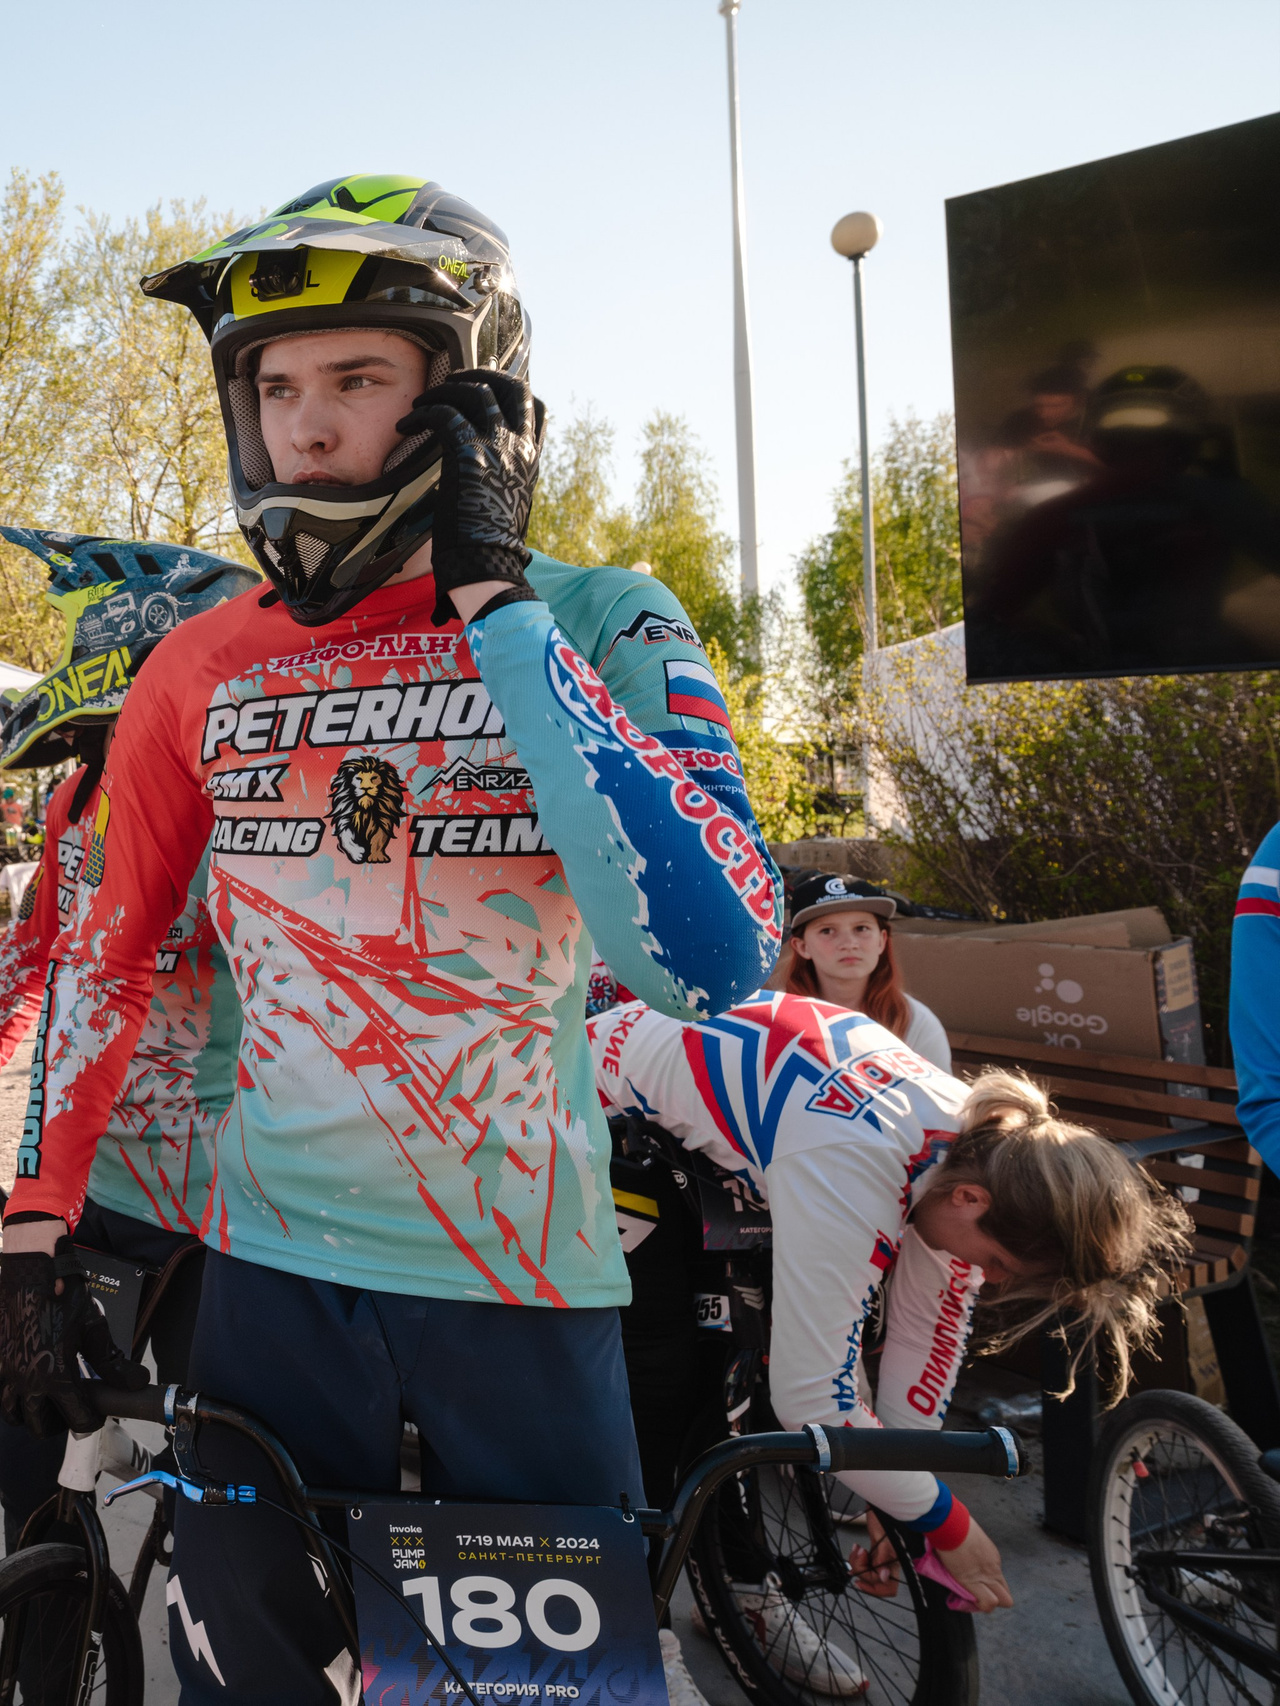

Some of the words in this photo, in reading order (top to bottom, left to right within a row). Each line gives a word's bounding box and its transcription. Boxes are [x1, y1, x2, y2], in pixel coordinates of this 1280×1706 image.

[1016, 1005, 1108, 1035] Google
[739, 1226, 773, 1234] КАТЕГОР
[98, 1274, 121, 1287] 2024
[697, 1296, 722, 1321] 55
[389, 1524, 422, 1533] invoke
[455, 1534, 493, 1546] 17-19
[496, 1535, 534, 1548] МАЯ
[555, 1537, 600, 1549] 2024
[392, 1548, 425, 1559] PUMP
[458, 1551, 602, 1564] САНКТ-ПЕТЕРБУРГ
[402, 1575, 601, 1652] 180
[545, 1684, 580, 1698] PRO
